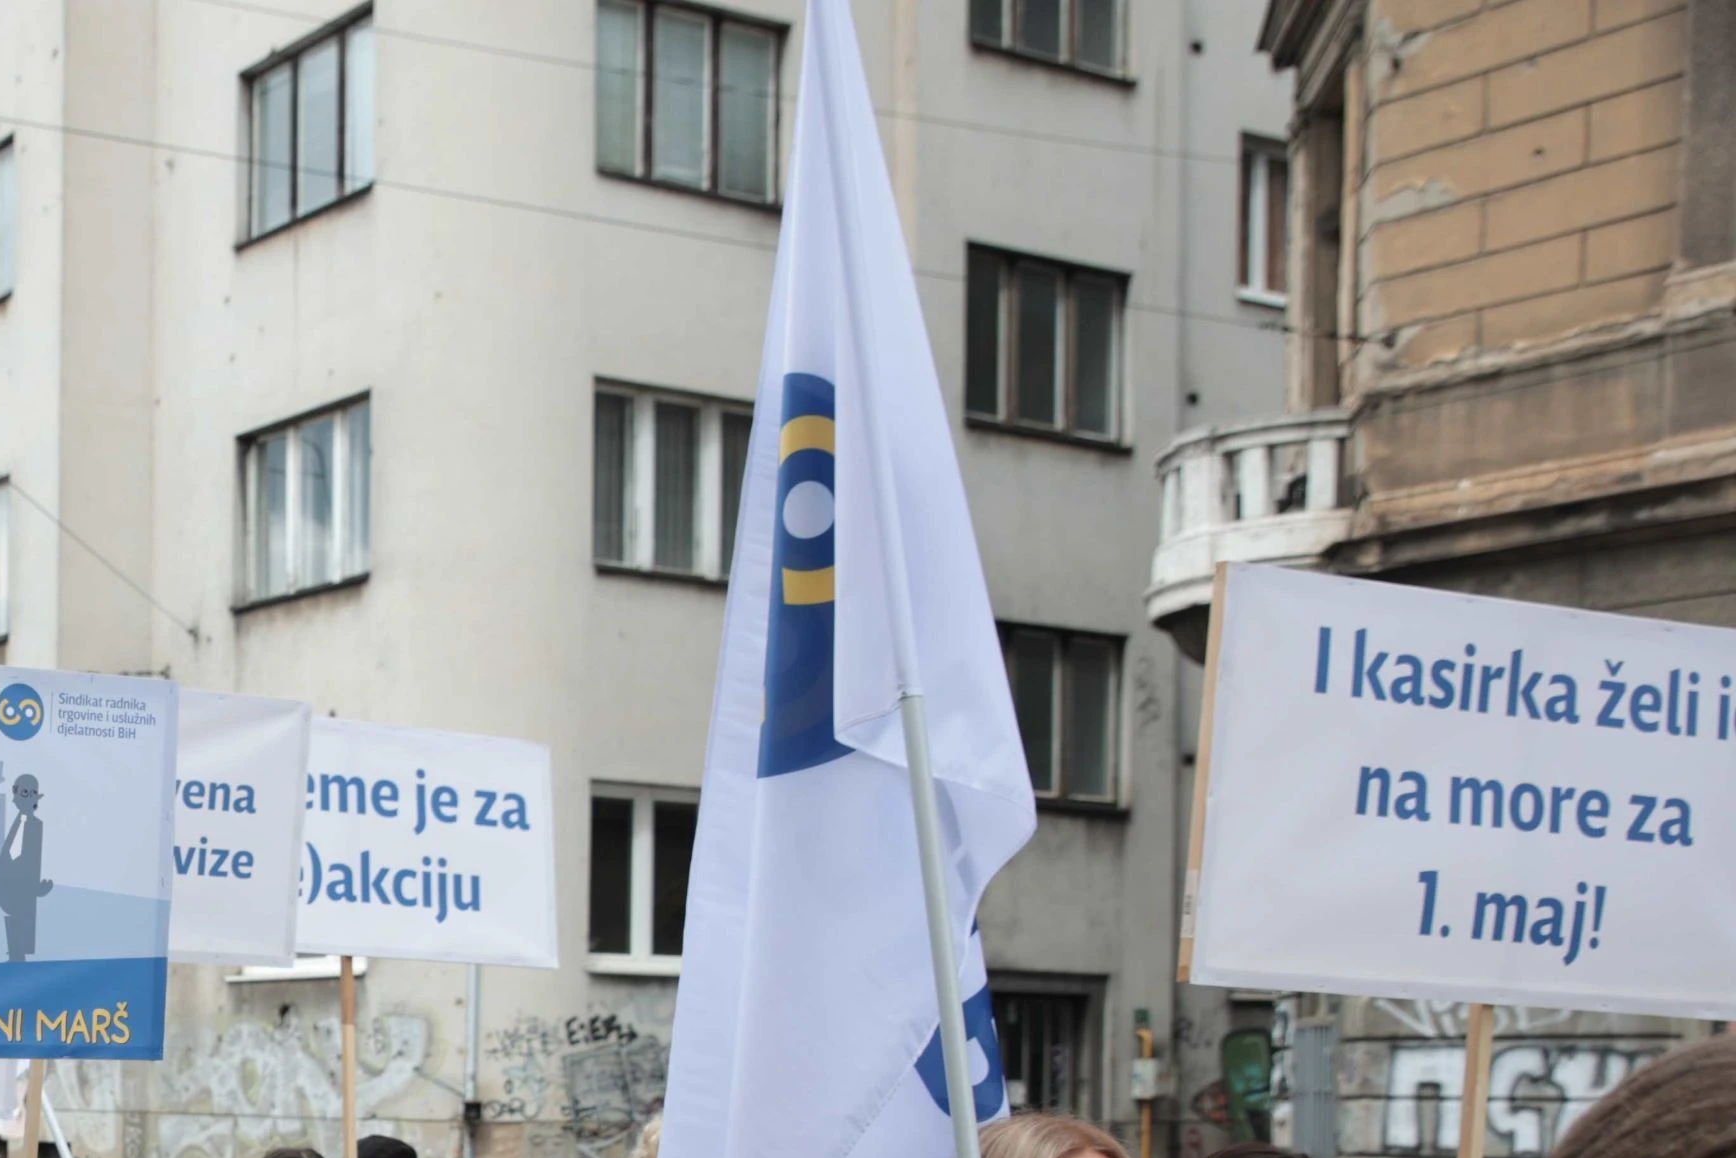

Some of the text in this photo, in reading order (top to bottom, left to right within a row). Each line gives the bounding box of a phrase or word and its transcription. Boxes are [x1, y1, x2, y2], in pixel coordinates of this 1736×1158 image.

[58, 693, 147, 712] Sindikat radnika
[1314, 626, 1736, 742] I kasirka želi i
[57, 708, 157, 726] trgovine i uslužnih
[57, 723, 137, 739] djelatnosti BiH
[176, 779, 257, 815] ena
[306, 768, 531, 835] me je za
[1355, 765, 1694, 847] na more za
[173, 836, 254, 880] vize
[299, 841, 481, 924] )akciju
[1417, 870, 1608, 967] 1. maj!
[35, 1000, 132, 1045] MARŠ
